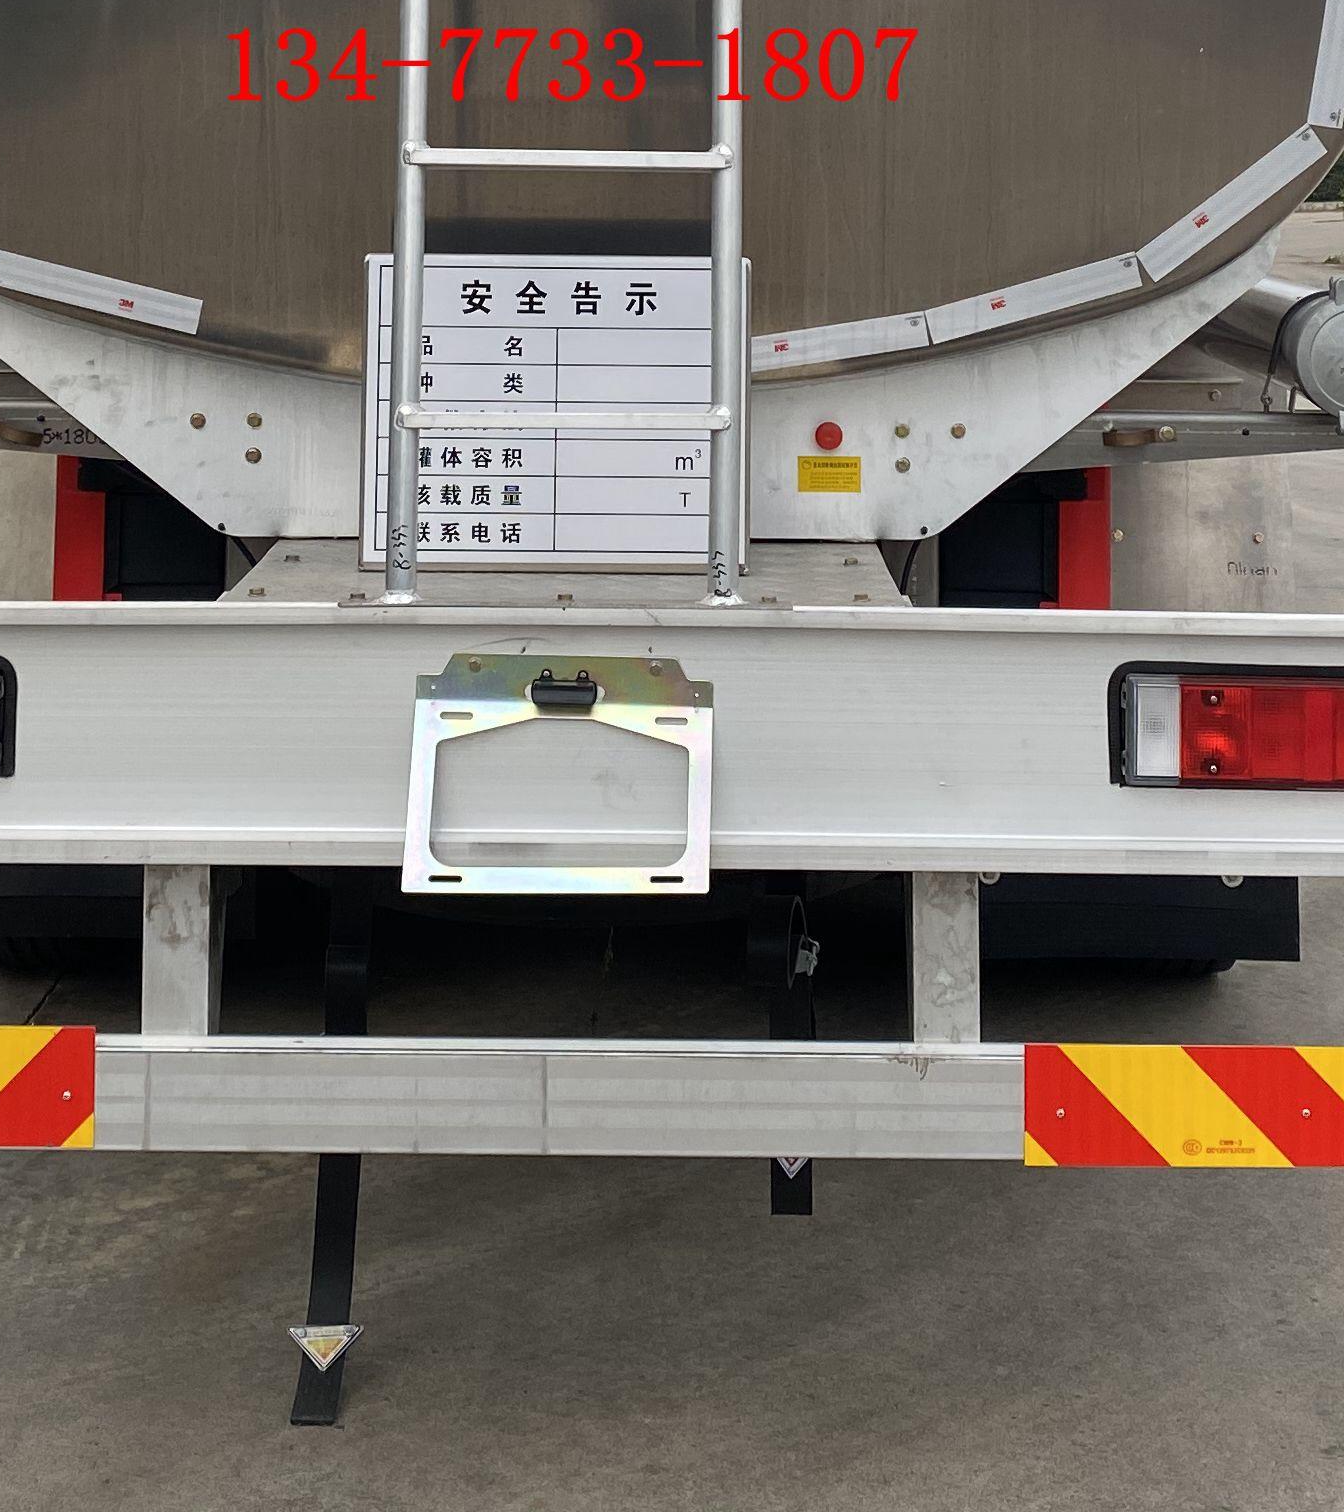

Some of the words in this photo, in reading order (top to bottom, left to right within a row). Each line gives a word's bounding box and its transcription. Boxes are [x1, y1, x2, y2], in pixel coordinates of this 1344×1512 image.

[460, 279, 658, 316] 安全告示
[679, 491, 692, 508] T
